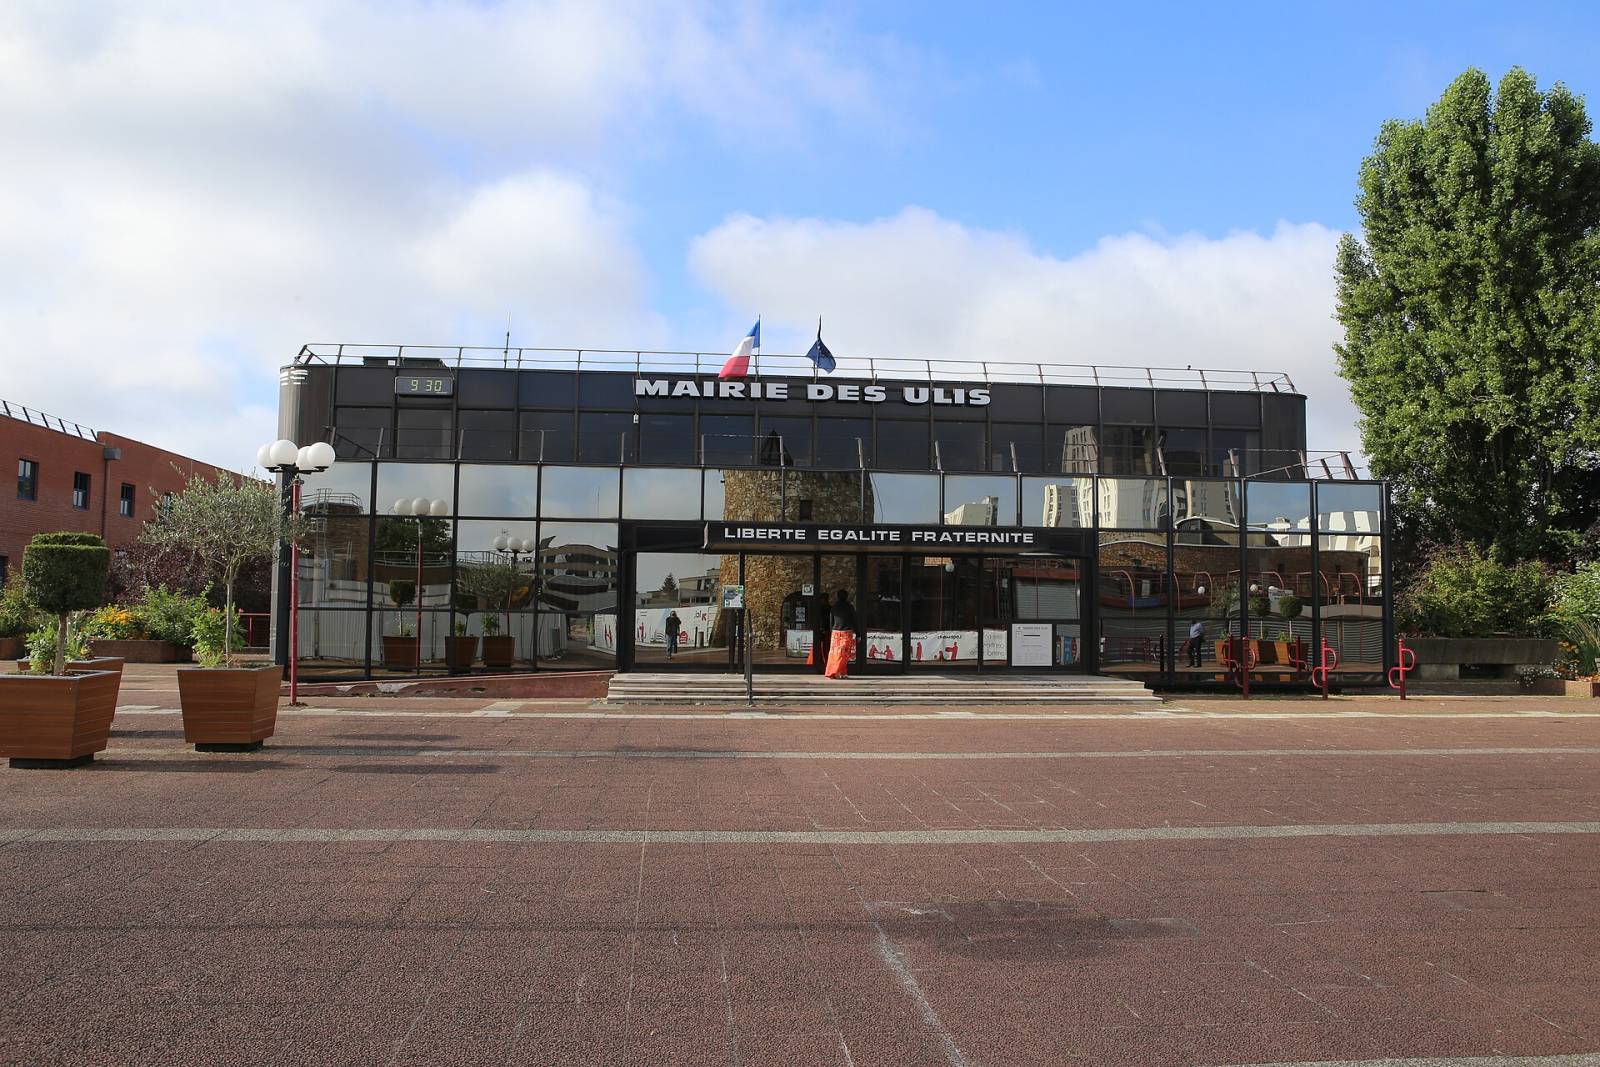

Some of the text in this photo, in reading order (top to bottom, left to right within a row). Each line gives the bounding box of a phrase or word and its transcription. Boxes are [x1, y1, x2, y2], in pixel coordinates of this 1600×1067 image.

[425, 380, 442, 392] 30
[635, 379, 991, 405] MAIRIE DES ULIS
[724, 527, 1034, 543] LIBERTE EGALITE FRATERNITE
